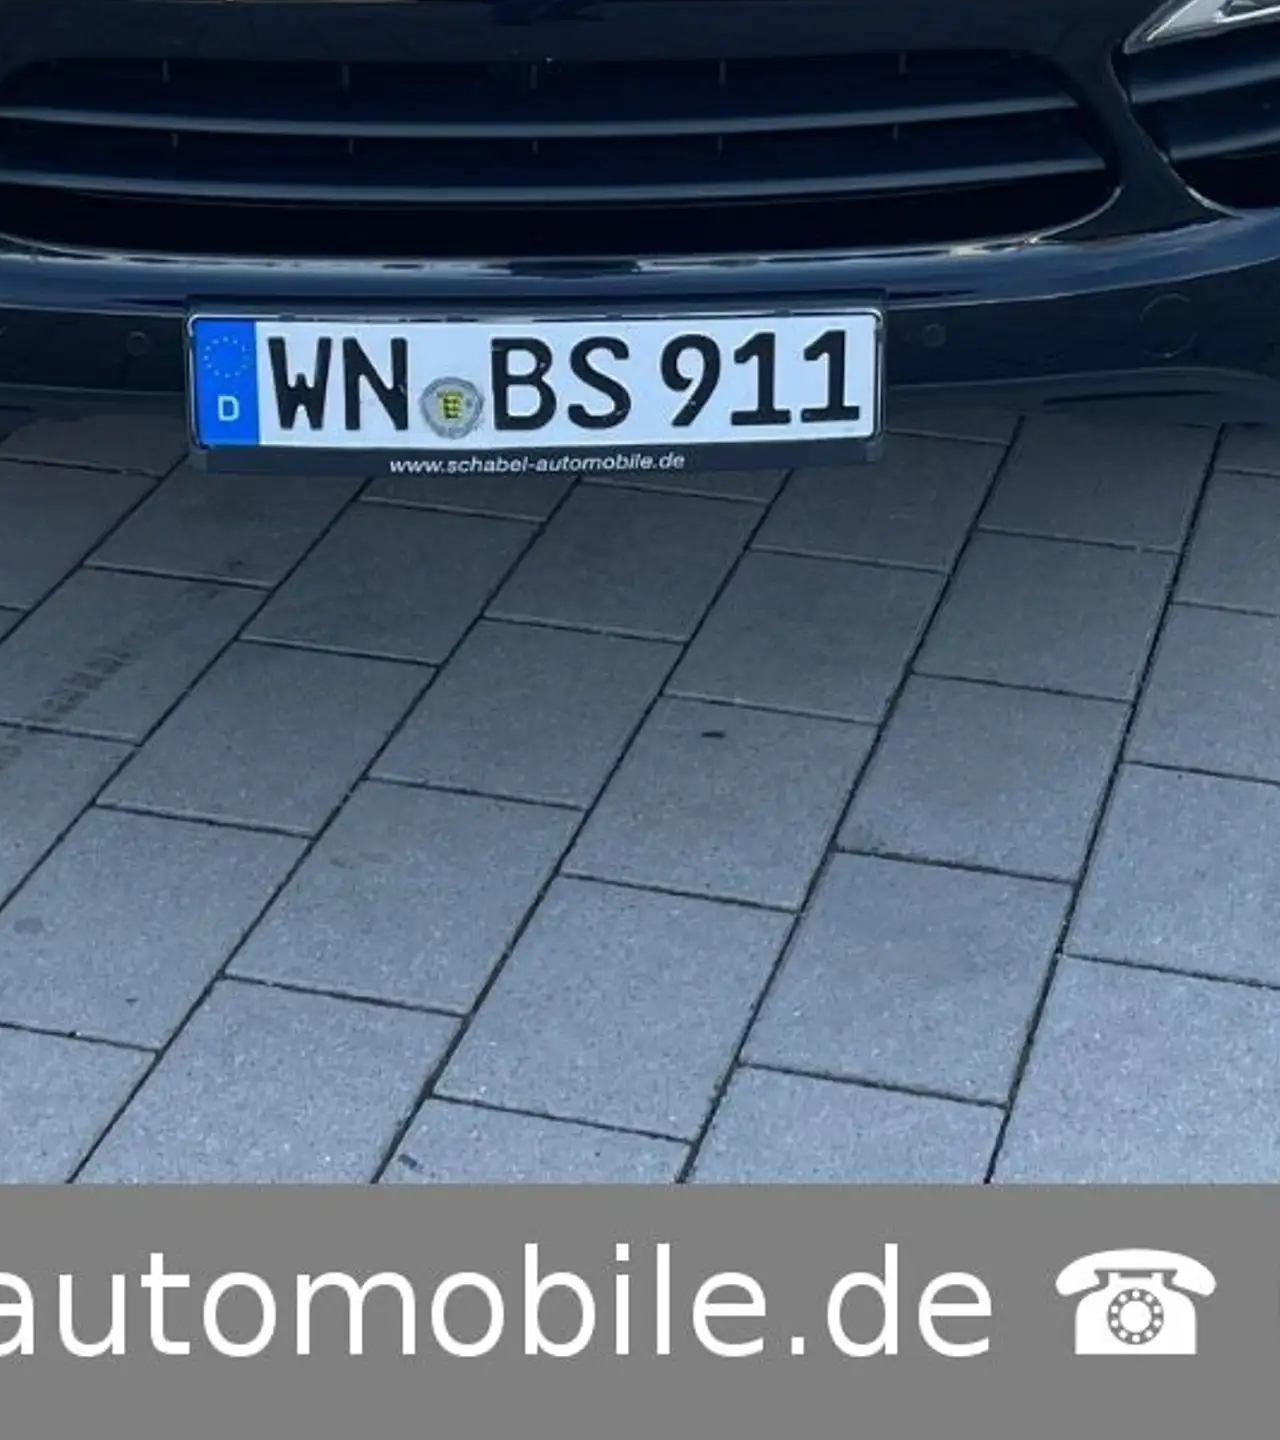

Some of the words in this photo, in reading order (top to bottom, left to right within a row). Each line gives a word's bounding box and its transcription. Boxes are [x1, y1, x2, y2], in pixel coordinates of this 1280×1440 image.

[217, 397, 239, 421] D
[268, 337, 409, 431] WN
[491, 336, 632, 430] BS
[660, 329, 861, 427] 911
[389, 453, 685, 473] www.schabel-automobile.de
